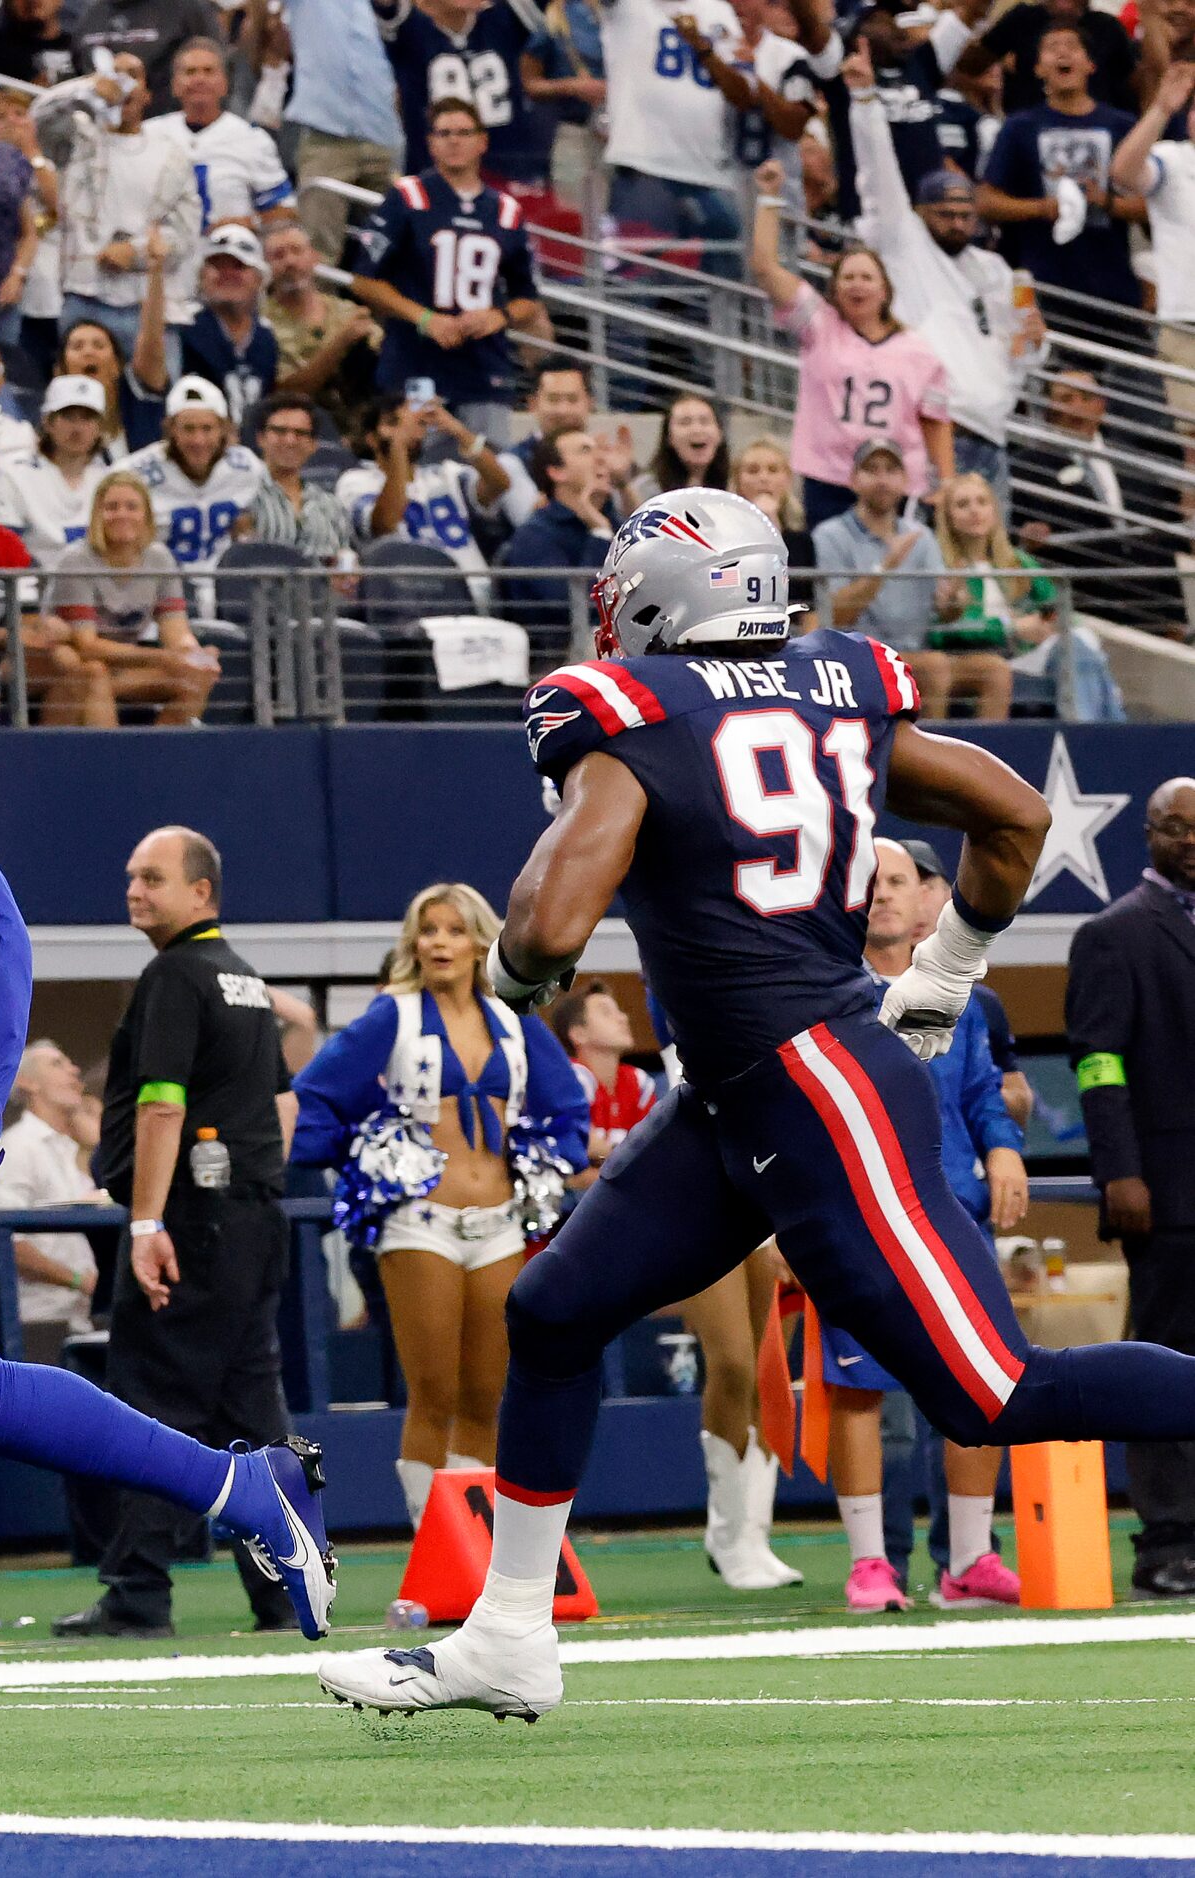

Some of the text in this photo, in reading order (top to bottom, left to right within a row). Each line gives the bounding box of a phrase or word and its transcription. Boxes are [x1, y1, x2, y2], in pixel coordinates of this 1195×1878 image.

[430, 230, 501, 312] 18
[840, 376, 892, 427] 12
[737, 621, 785, 637] PATRIOTS
[686, 660, 857, 707] WISE JR
[711, 708, 879, 917] 91
